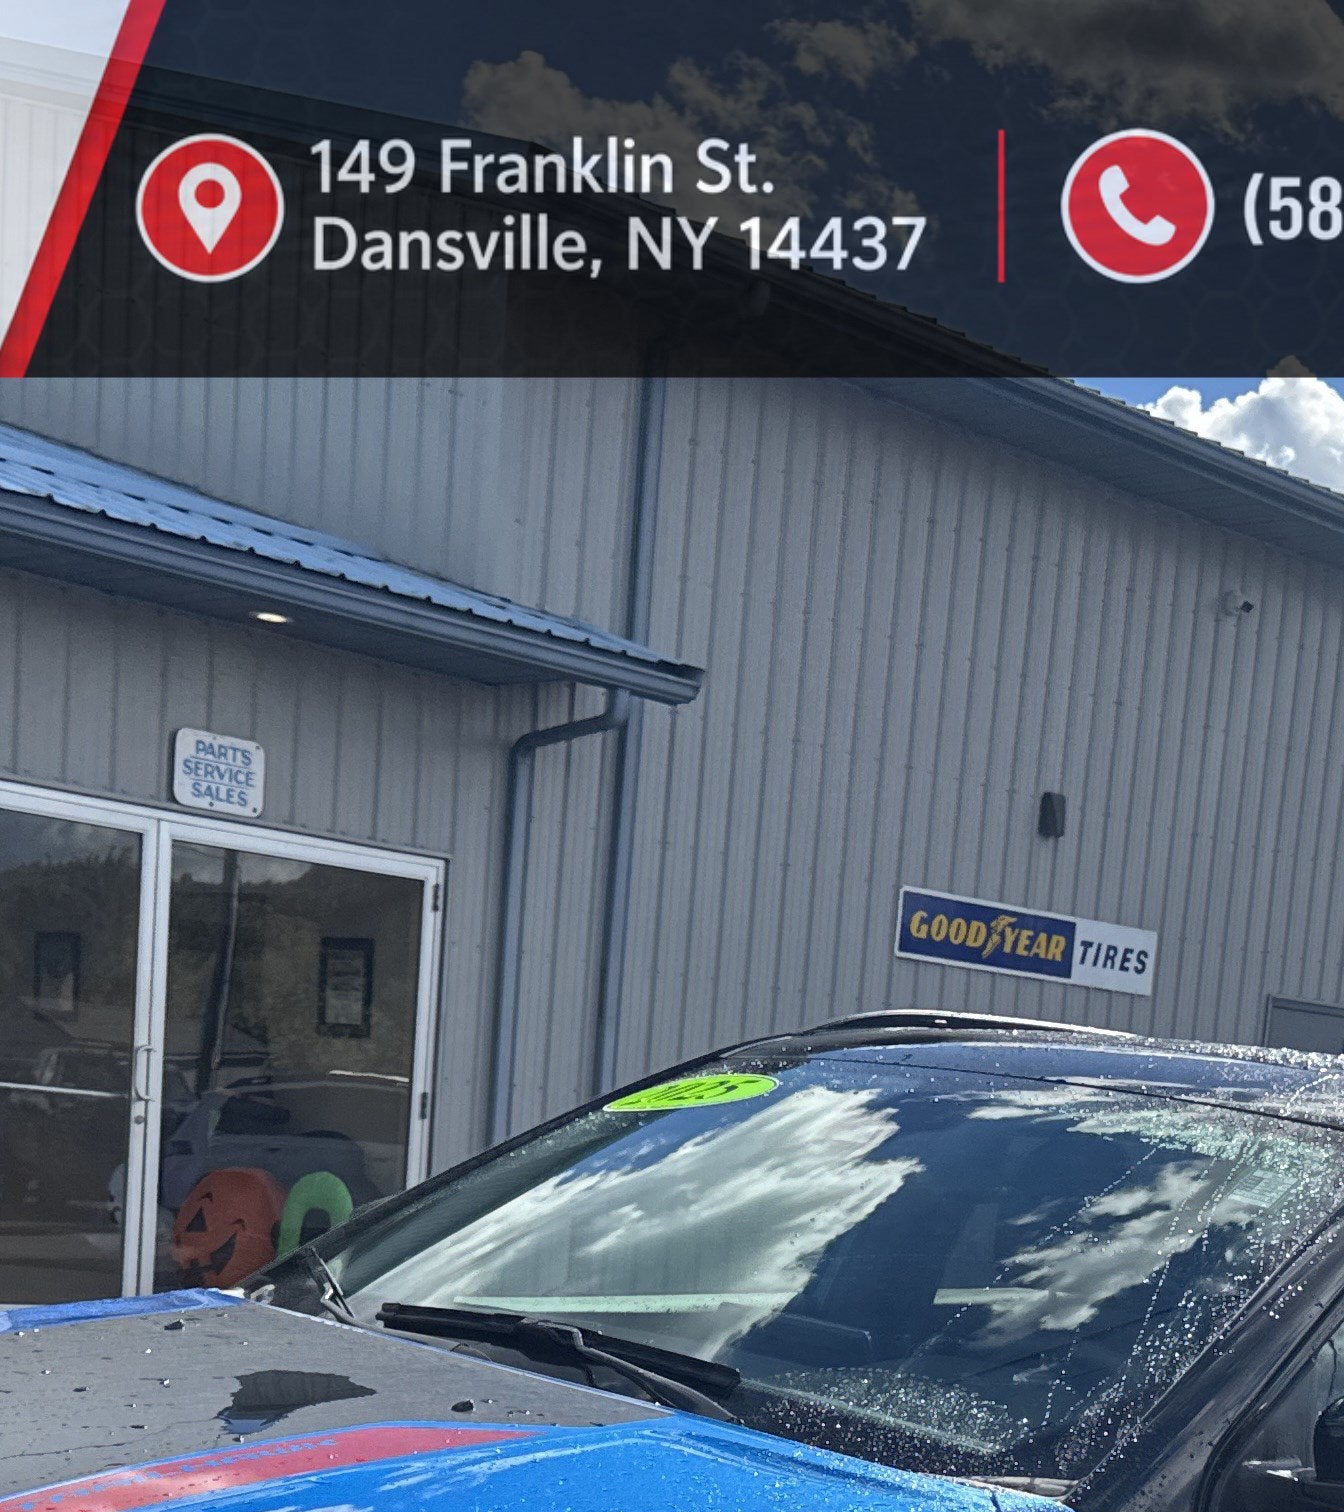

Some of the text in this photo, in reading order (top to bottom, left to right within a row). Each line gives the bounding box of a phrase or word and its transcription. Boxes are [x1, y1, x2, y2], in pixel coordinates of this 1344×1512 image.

[195, 740, 252, 767] PARTS
[182, 758, 255, 788] SERVICE
[191, 781, 248, 807] SALES
[910, 910, 1150, 975] GOODYEAR TIRES
